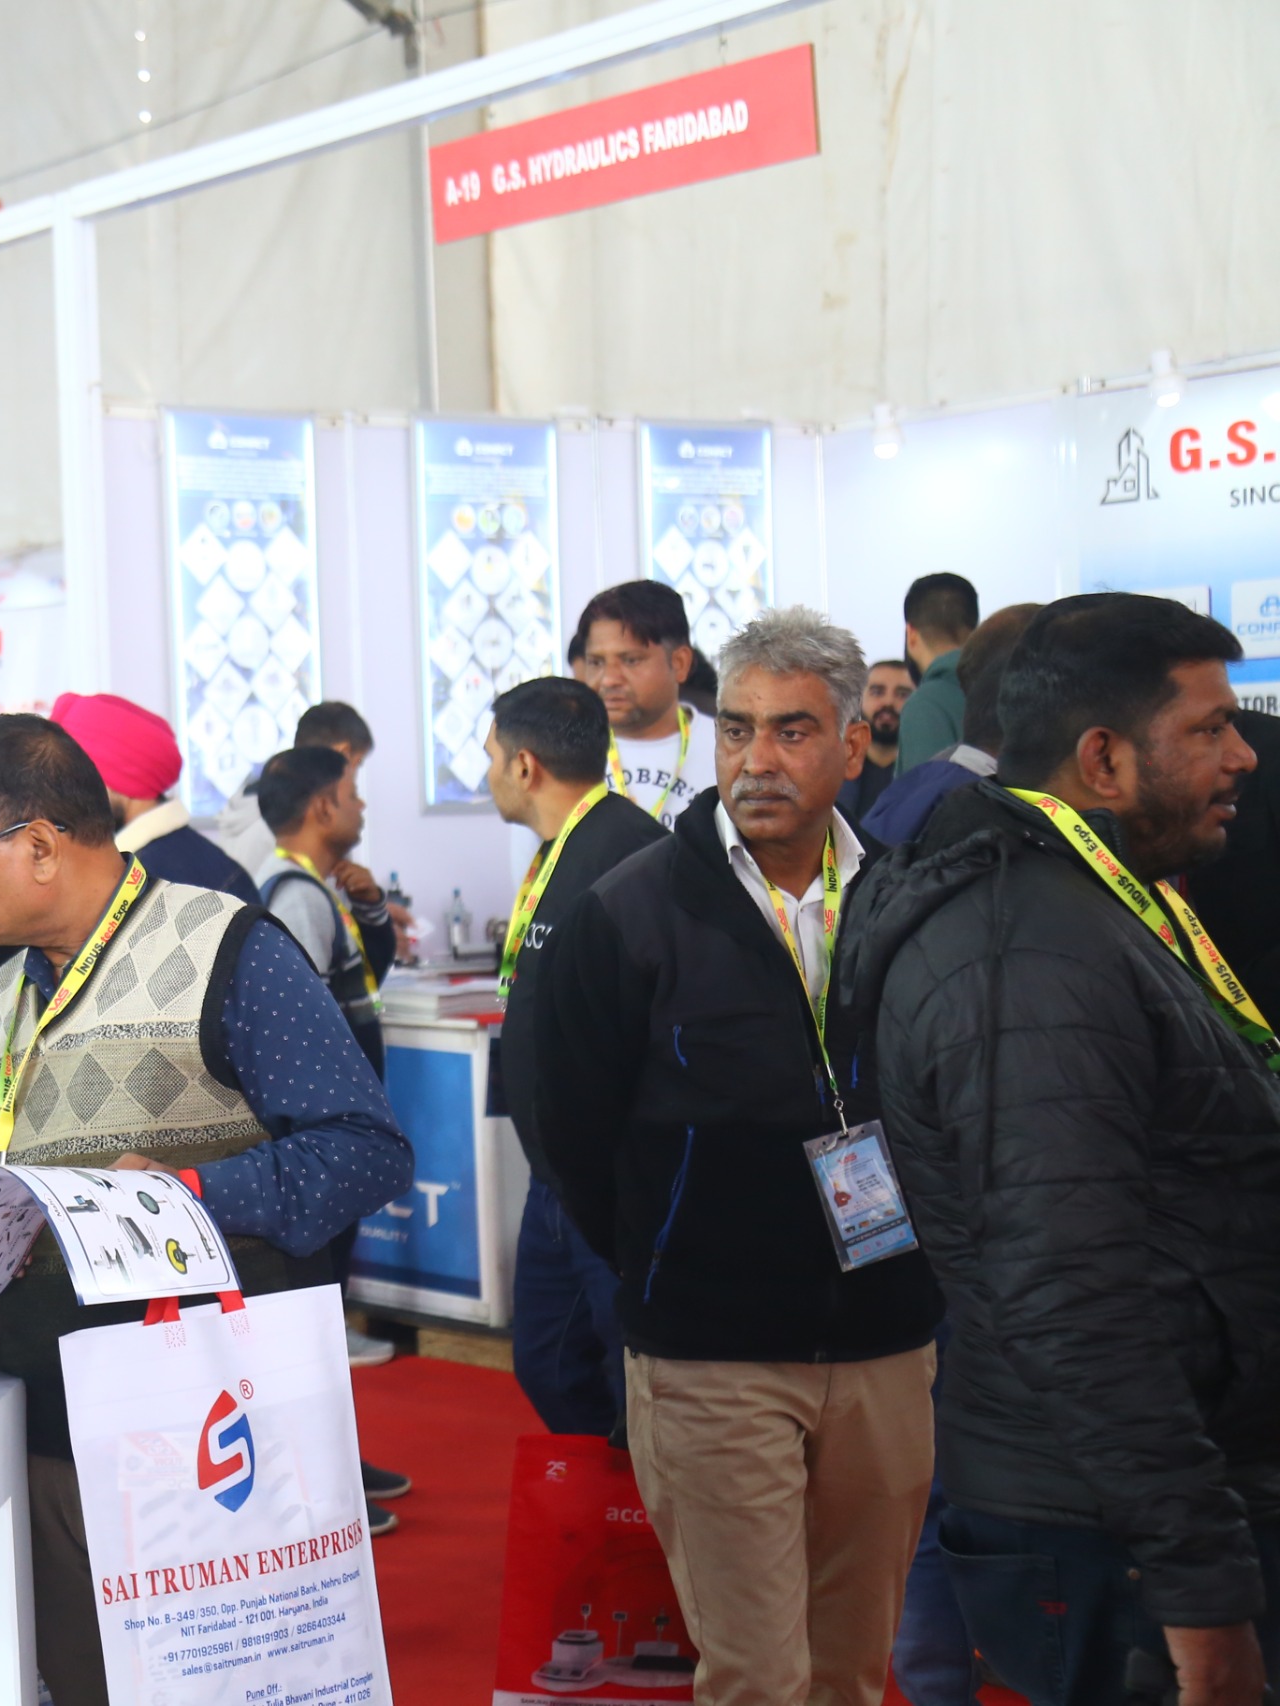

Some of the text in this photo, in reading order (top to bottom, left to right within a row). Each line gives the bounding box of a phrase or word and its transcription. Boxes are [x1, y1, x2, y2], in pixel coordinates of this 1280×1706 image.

[444, 99, 749, 206] A-19 G.S. HYDRAULICS FARIDABAD
[1169, 419, 1277, 475] G.S.
[1073, 824, 1098, 853] Expo
[112, 899, 129, 922] Expo
[1183, 907, 1202, 938] Expo
[48, 987, 70, 1013] VAS
[102, 1518, 363, 1605] SAI TRUMAN ENTERPRISES
[124, 1615, 146, 1631] Shop
[147, 1616, 163, 1626] No.
[221, 1603, 238, 1615] Opp.
[240, 1595, 267, 1611] Punjab
[269, 1587, 300, 1604] National
[321, 1575, 342, 1590] Nehru
[180, 1626, 196, 1637] NIT
[198, 1617, 237, 1634] Faridabad
[245, 1614, 258, 1625] 121
[312, 1596, 328, 1609] India
[242, 1628, 289, 1648] 9818191903
[182, 1633, 335, 1676] sales@saitruman.in www.saitruman.in
[246, 1690, 265, 1701] Pune
[285, 1690, 313, 1705] Bhavani
[315, 1679, 349, 1696] Industrial
[344, 1692, 356, 1704] 411
[357, 1688, 371, 1701] 026
